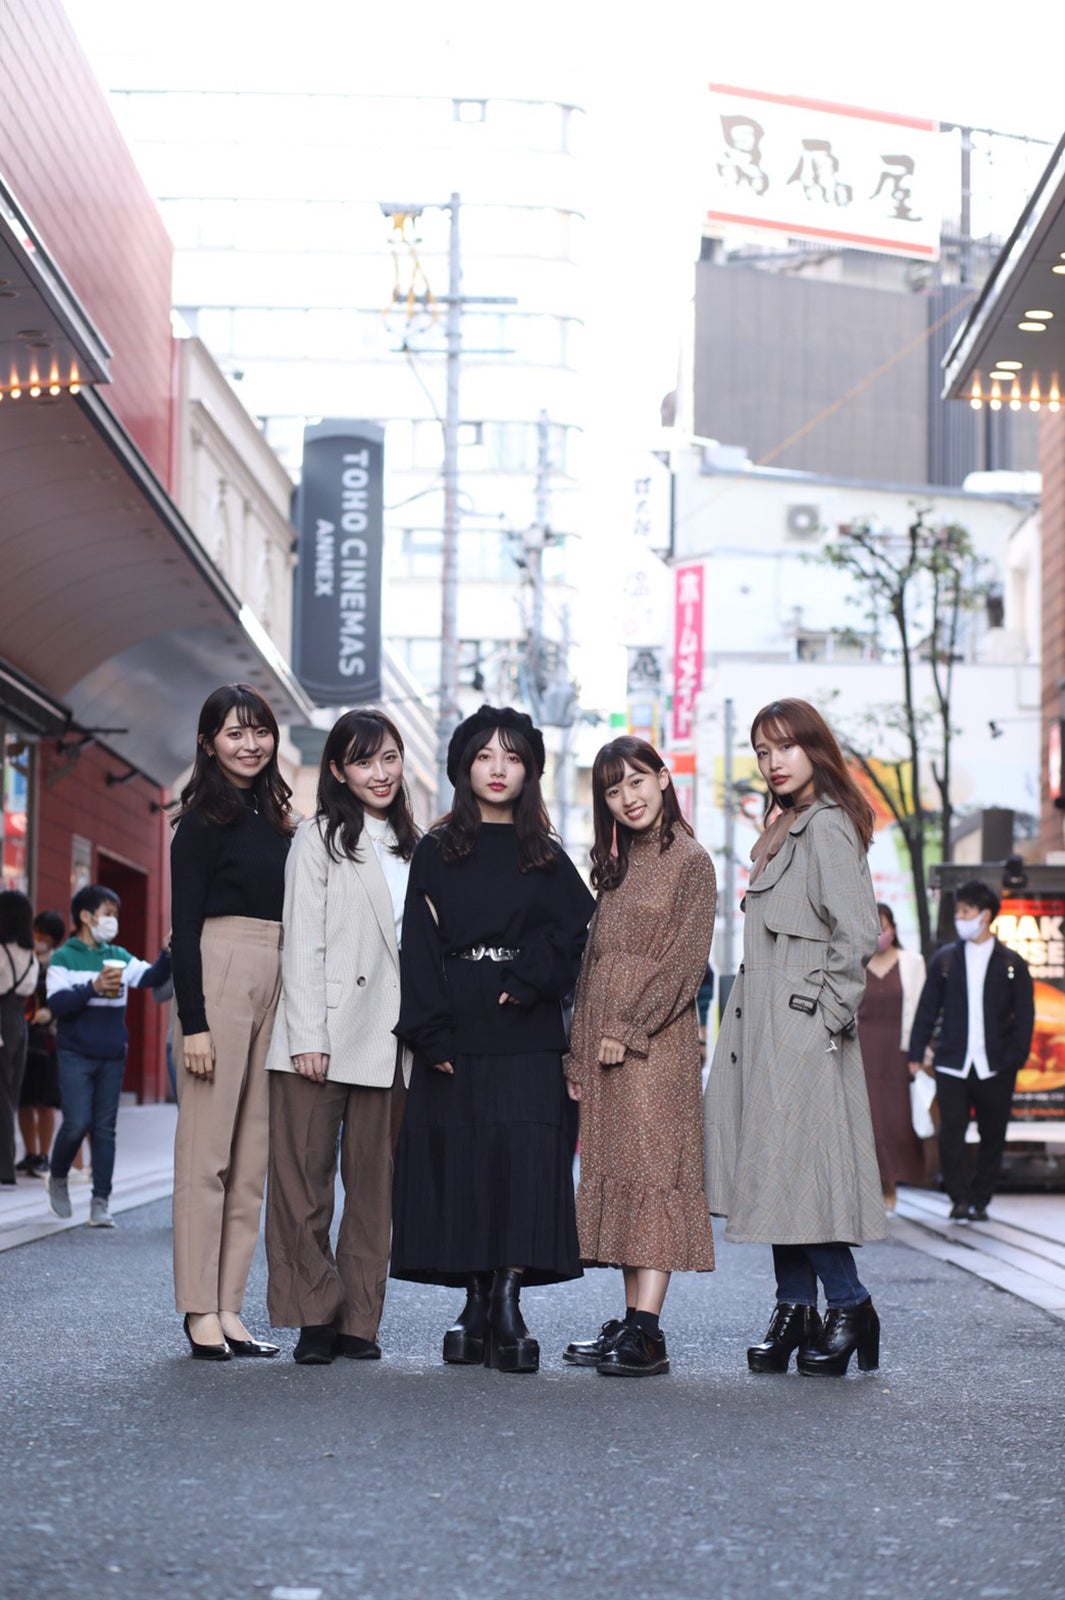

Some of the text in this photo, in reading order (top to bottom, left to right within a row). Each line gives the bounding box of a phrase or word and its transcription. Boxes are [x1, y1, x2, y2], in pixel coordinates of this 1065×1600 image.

[314, 518, 335, 597] ANNEX
[338, 449, 369, 677] TOHO CINEMAS
